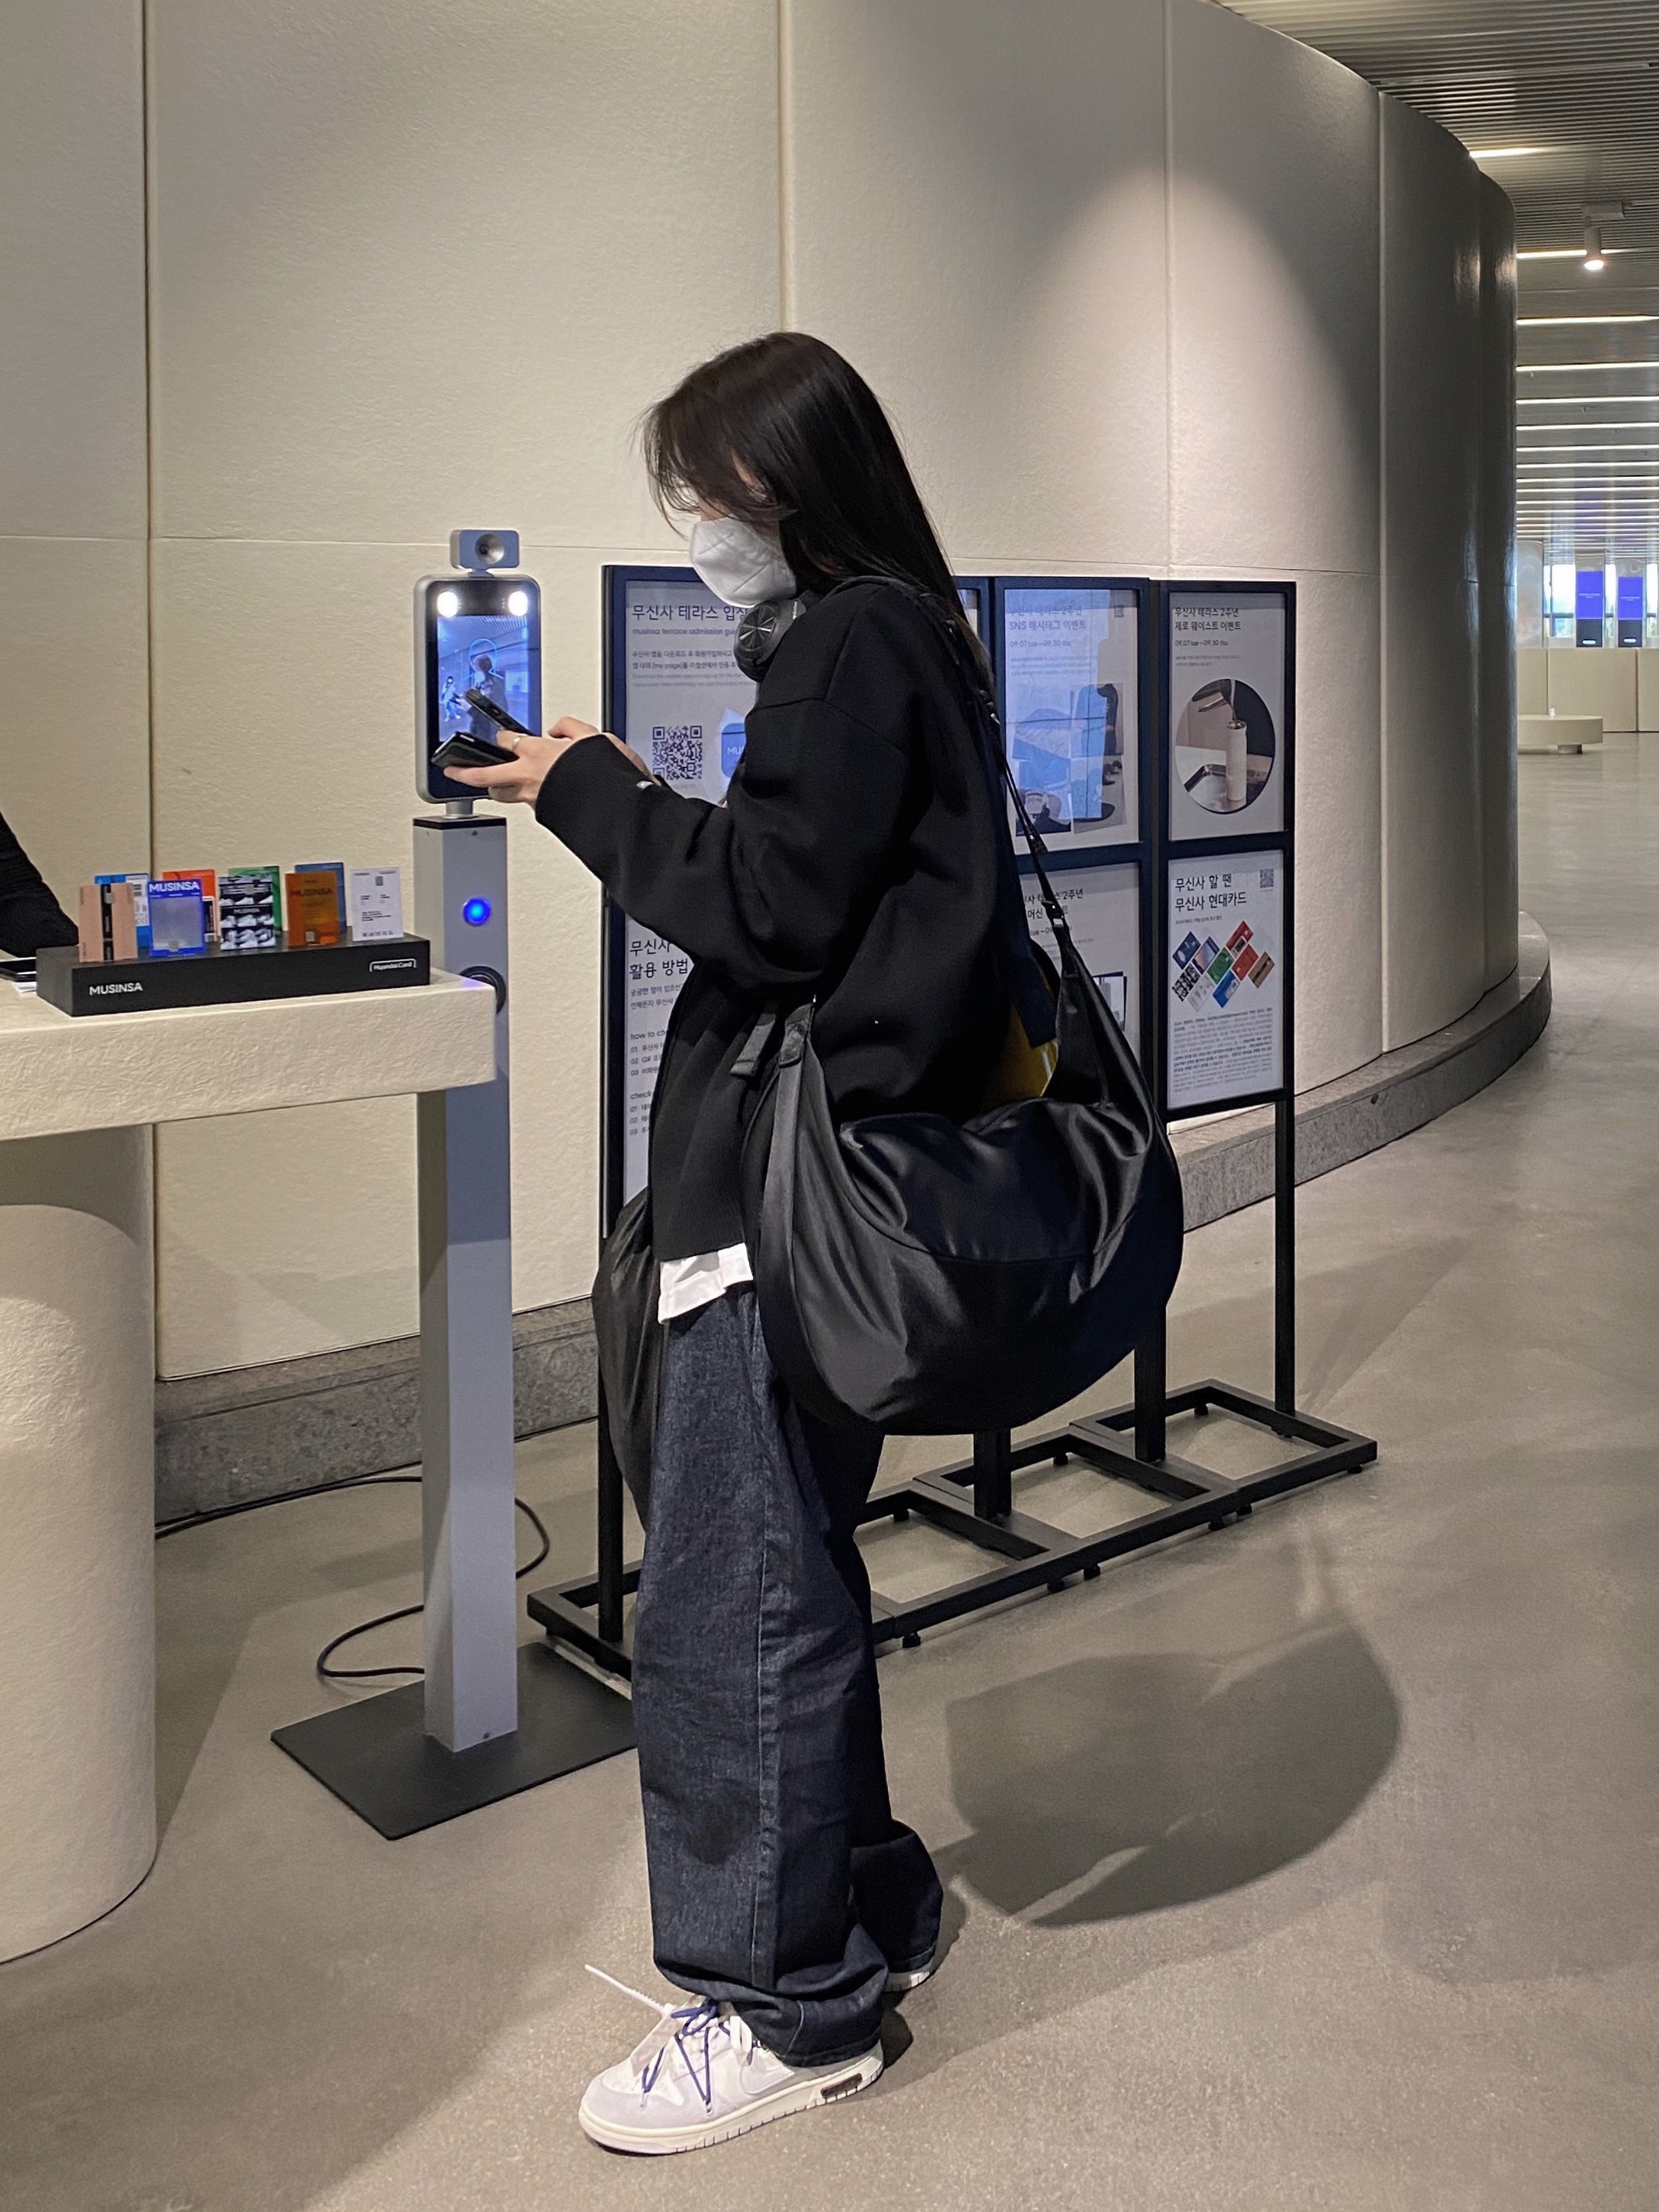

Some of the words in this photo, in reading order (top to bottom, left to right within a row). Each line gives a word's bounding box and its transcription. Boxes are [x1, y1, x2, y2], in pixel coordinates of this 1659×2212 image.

[632, 605, 674, 621] 무신사
[678, 605, 719, 620] 테라스
[1175, 607, 1196, 617] 무신사
[1198, 607, 1219, 617] 테라스
[1220, 607, 1239, 617] 2주년
[1009, 620, 1026, 630] SNS
[1029, 620, 1061, 631] 해시태그
[1063, 620, 1086, 630] 이벤트
[1175, 621, 1189, 631] 제로
[1191, 621, 1218, 631] 웨이스트
[1221, 621, 1241, 631] 이벤트
[149, 881, 200, 893] MUSINSA
[1175, 876, 1205, 892] 무신사
[1209, 874, 1218, 889] 할
[1222, 873, 1232, 888] 땐
[1063, 888, 1083, 900] 2주년
[1175, 896, 1205, 912] 무신사
[1209, 892, 1247, 909] 현대카드
[1028, 908, 1042, 919] 머신
[630, 962, 657, 980] 활용
[662, 958, 688, 976] 방법
[90, 982, 143, 995] MUSINSA
